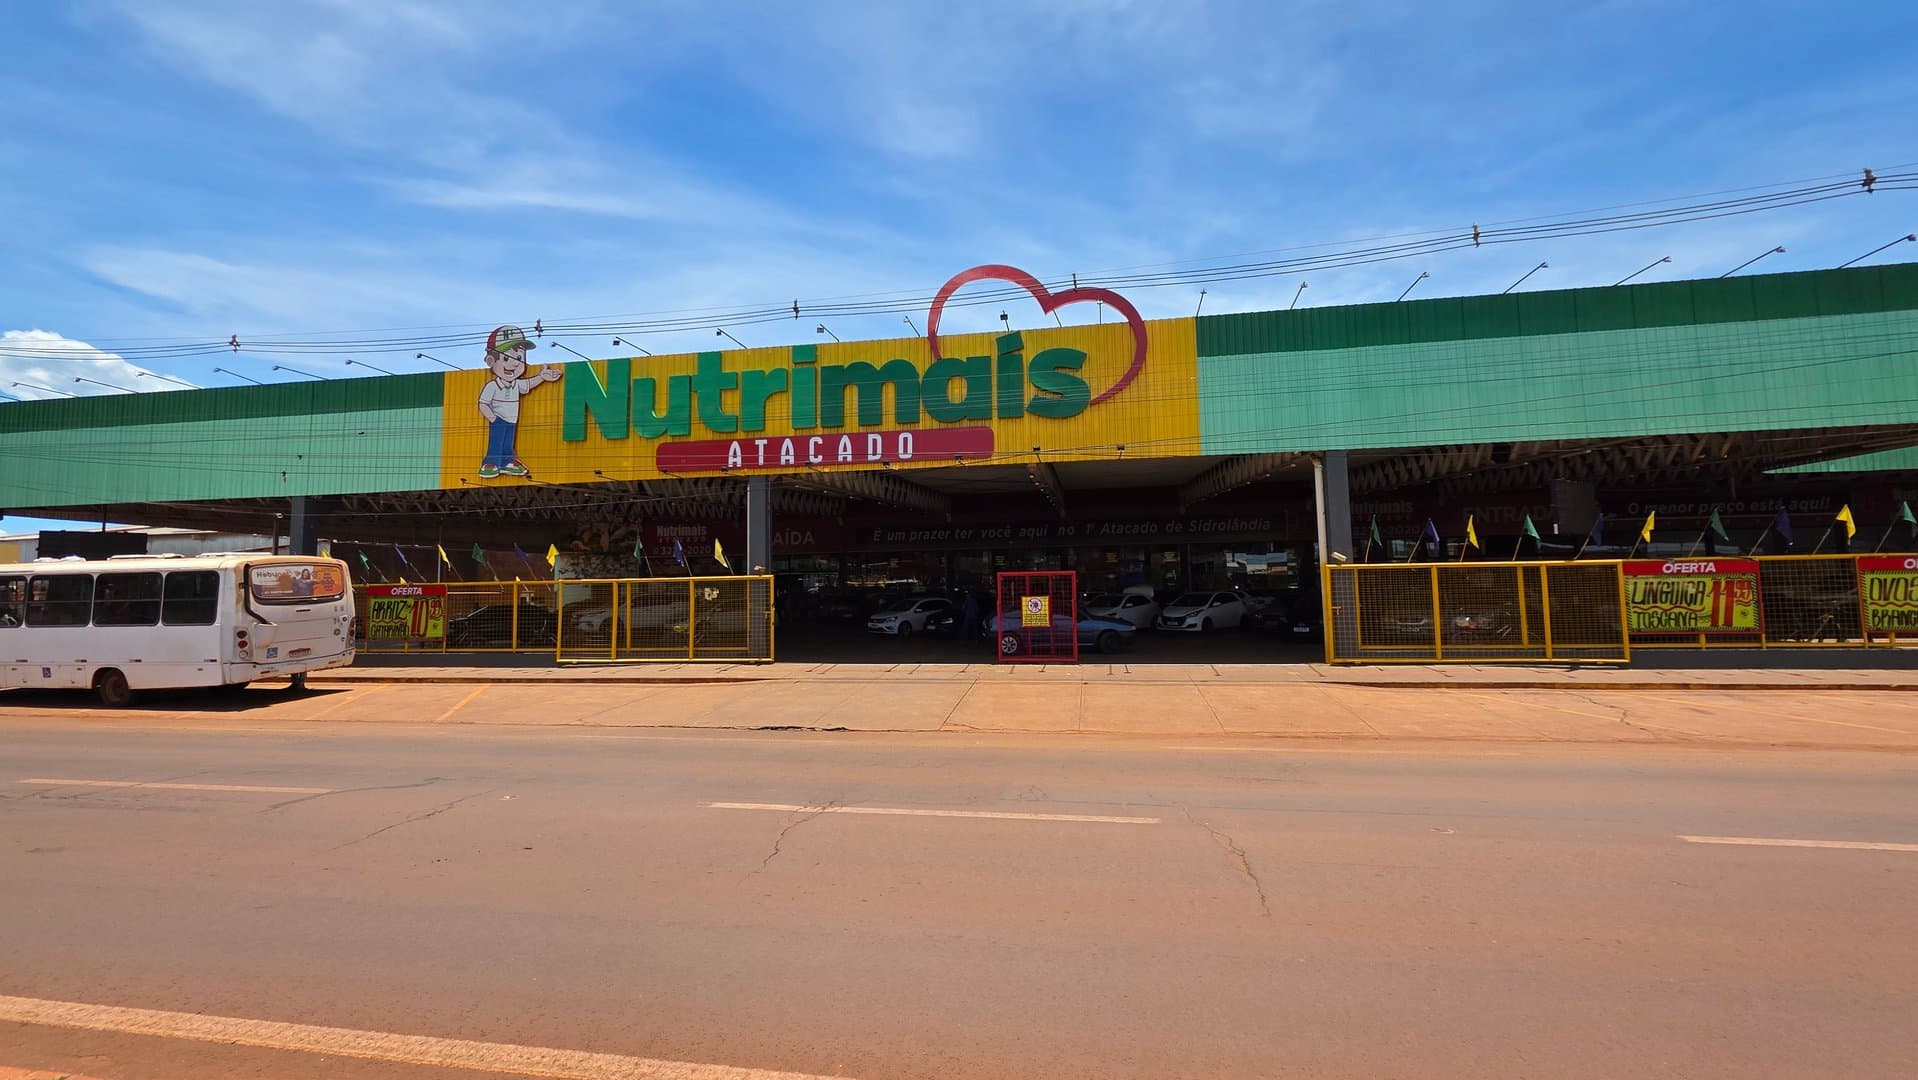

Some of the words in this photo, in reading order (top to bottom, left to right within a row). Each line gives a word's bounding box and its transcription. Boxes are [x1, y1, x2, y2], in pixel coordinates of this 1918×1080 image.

[728, 432, 913, 467] ATACADO
[1628, 502, 1639, 514] O
[887, 531, 905, 541] um
[908, 529, 951, 544] prazer
[955, 527, 973, 540] ter
[981, 525, 1011, 538] você
[1019, 524, 1048, 541] aqui
[1058, 526, 1075, 536] no
[1100, 521, 1158, 535] Atacado
[1165, 520, 1183, 532] de
[1189, 517, 1270, 533] Sidrolândia
[1661, 561, 1717, 574] OFERTA
[391, 587, 422, 596] OFERTA
[372, 600, 407, 620] ARROZ
[1633, 610, 1698, 628] TOSCANA
